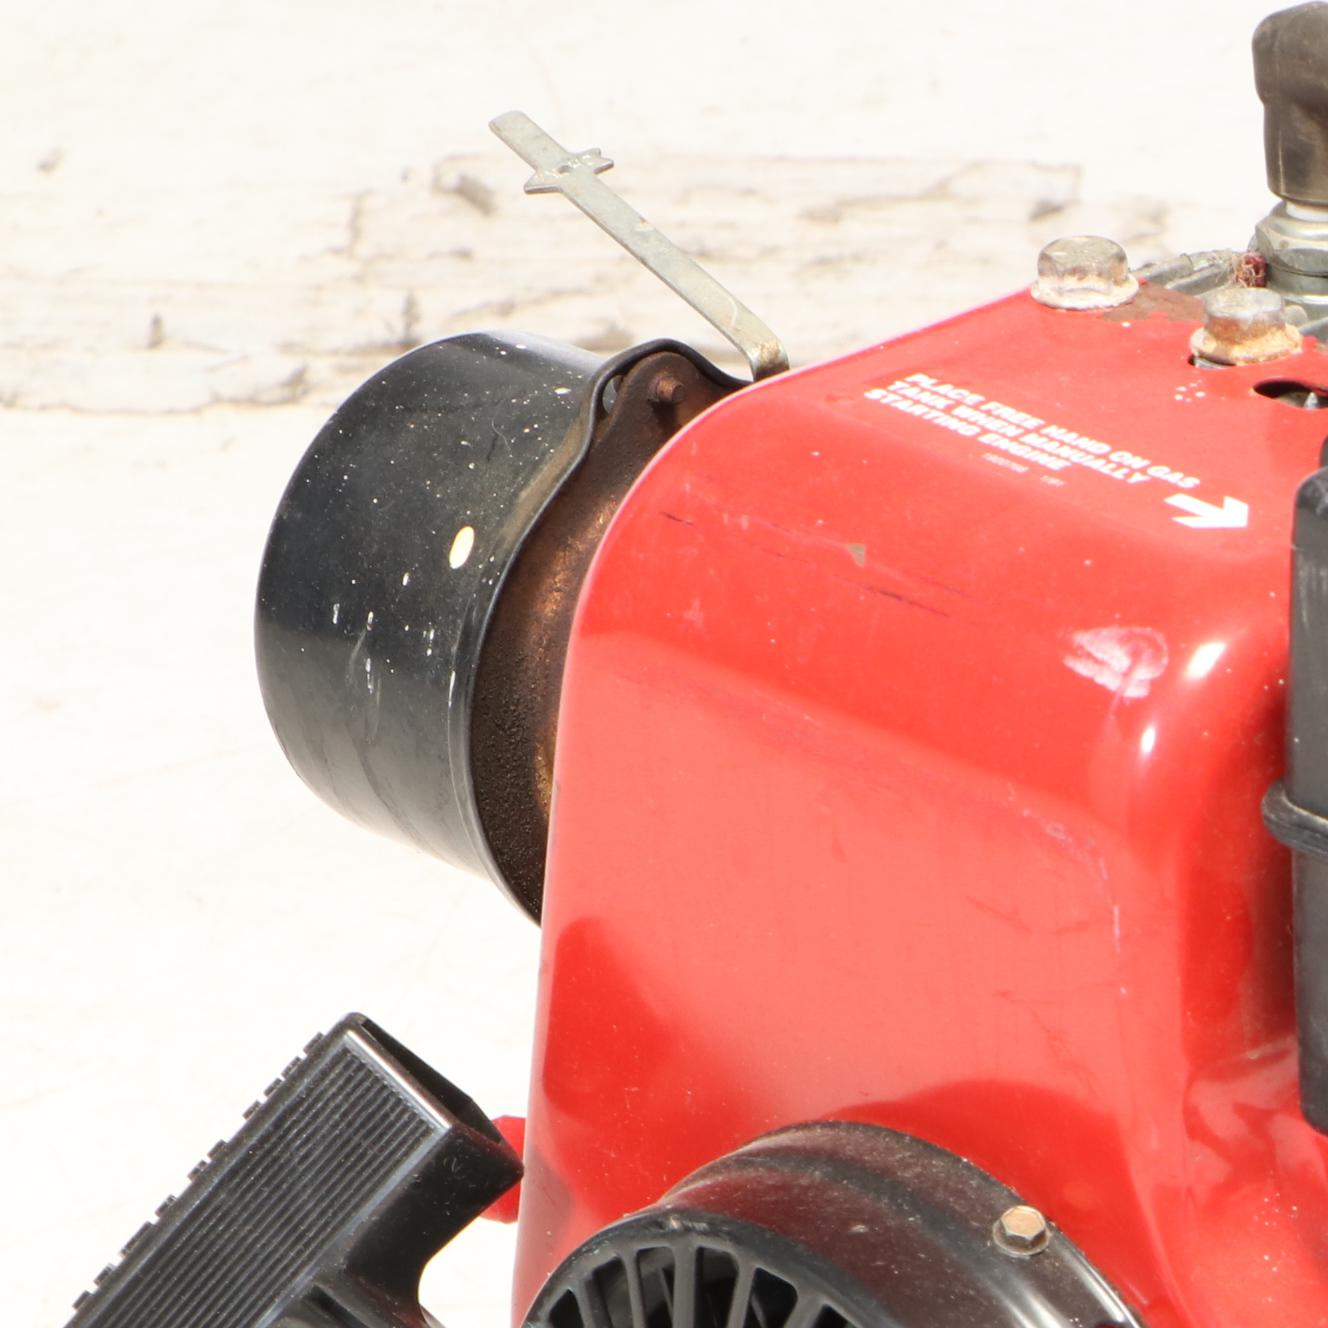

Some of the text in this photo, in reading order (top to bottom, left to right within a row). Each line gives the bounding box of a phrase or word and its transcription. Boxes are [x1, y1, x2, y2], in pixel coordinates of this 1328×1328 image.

[864, 389, 981, 436] STARTING
[977, 433, 1072, 470] ENGINE
[888, 381, 954, 409] TANK
[951, 405, 1024, 437] WHEN
[1019, 433, 1150, 483] MANUALLY
[905, 374, 1200, 488] PLACE FREE HAND ON GAS
